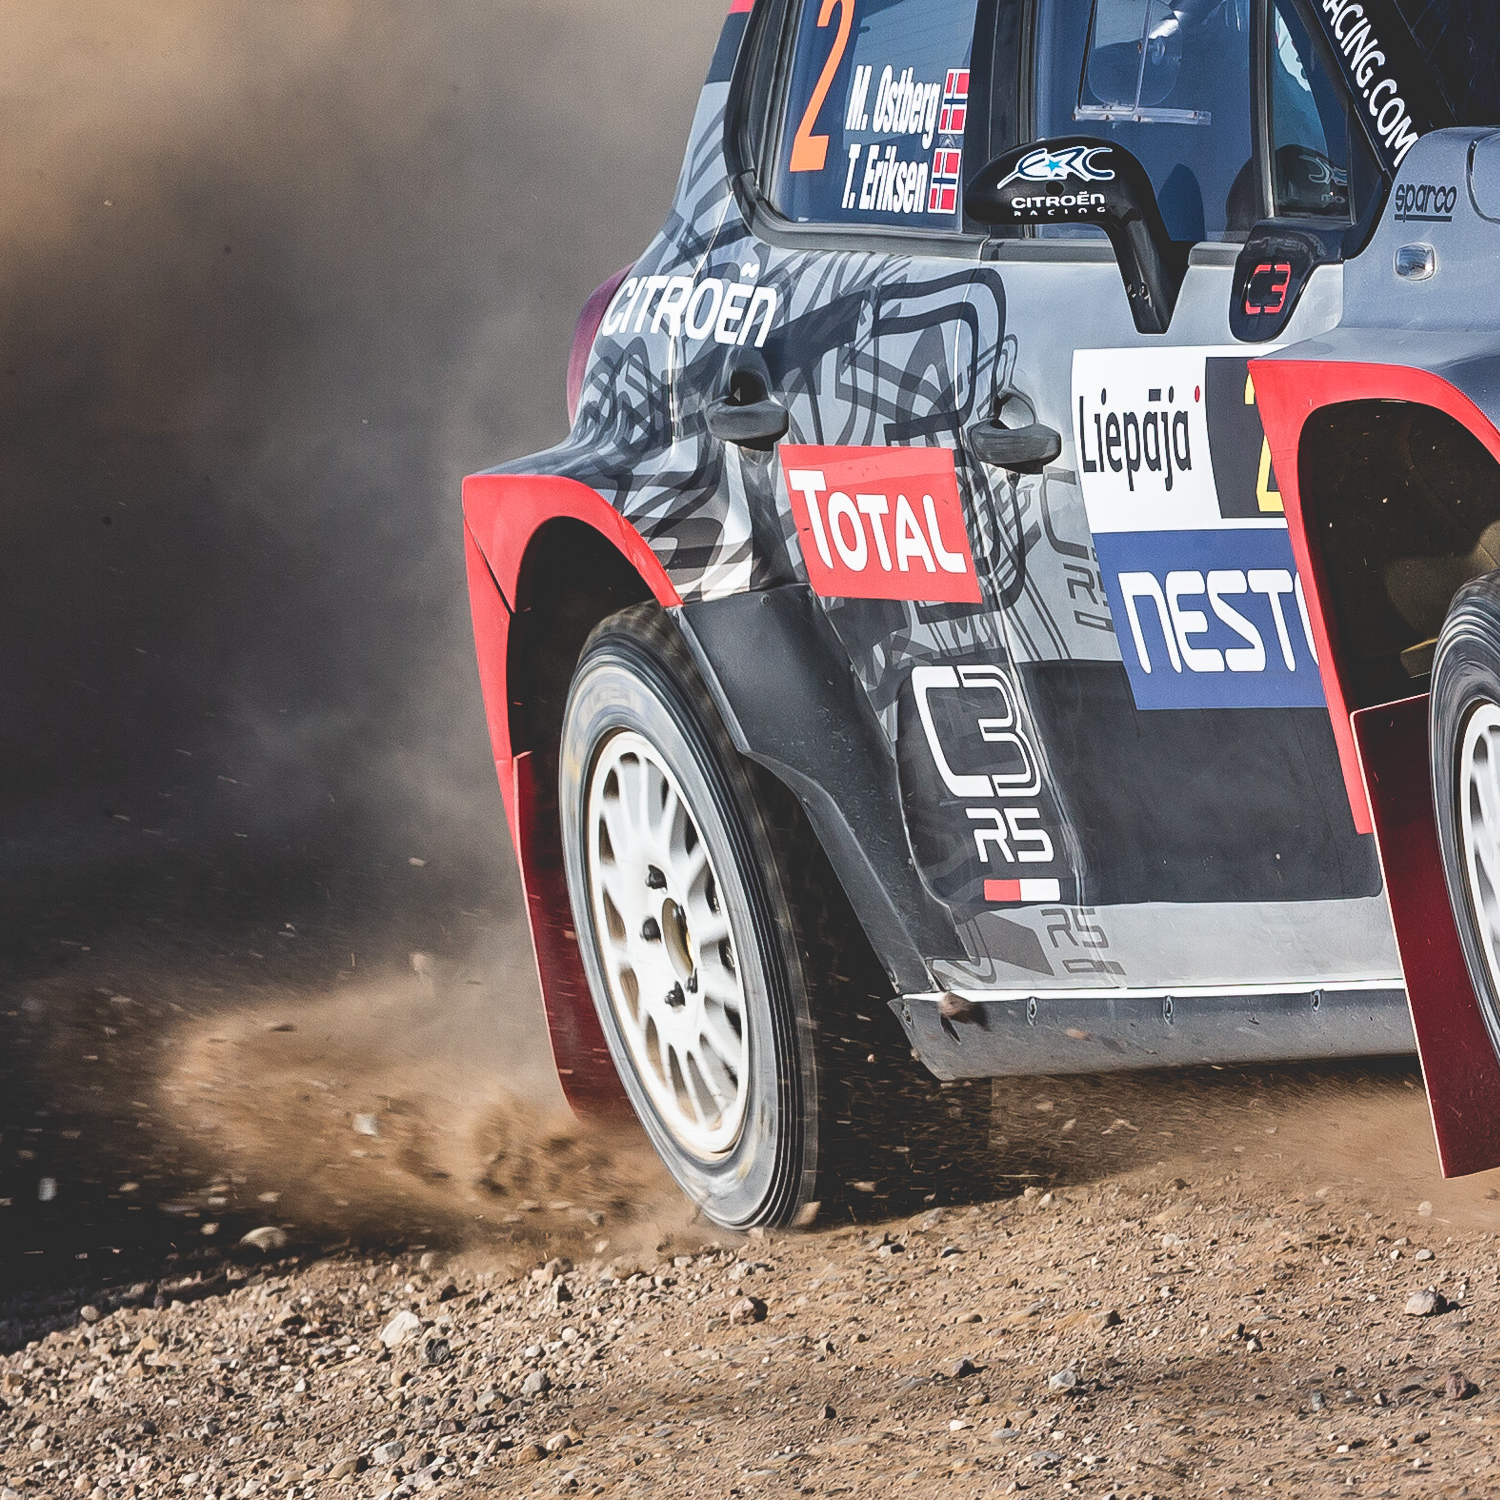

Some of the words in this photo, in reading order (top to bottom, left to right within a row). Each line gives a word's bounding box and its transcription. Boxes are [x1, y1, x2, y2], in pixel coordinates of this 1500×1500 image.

[845, 64, 873, 131] M.
[872, 64, 941, 150] Ostberg
[841, 143, 862, 209] T.
[858, 144, 929, 214] Eriksen
[1013, 207, 1106, 217] RACING
[1394, 183, 1457, 223] sparco
[1079, 386, 1193, 492] Liepāja
[788, 469, 968, 574] TOTAL
[1117, 569, 1318, 674] NEST
[911, 664, 1043, 798] C3
[965, 807, 1054, 863] R5
